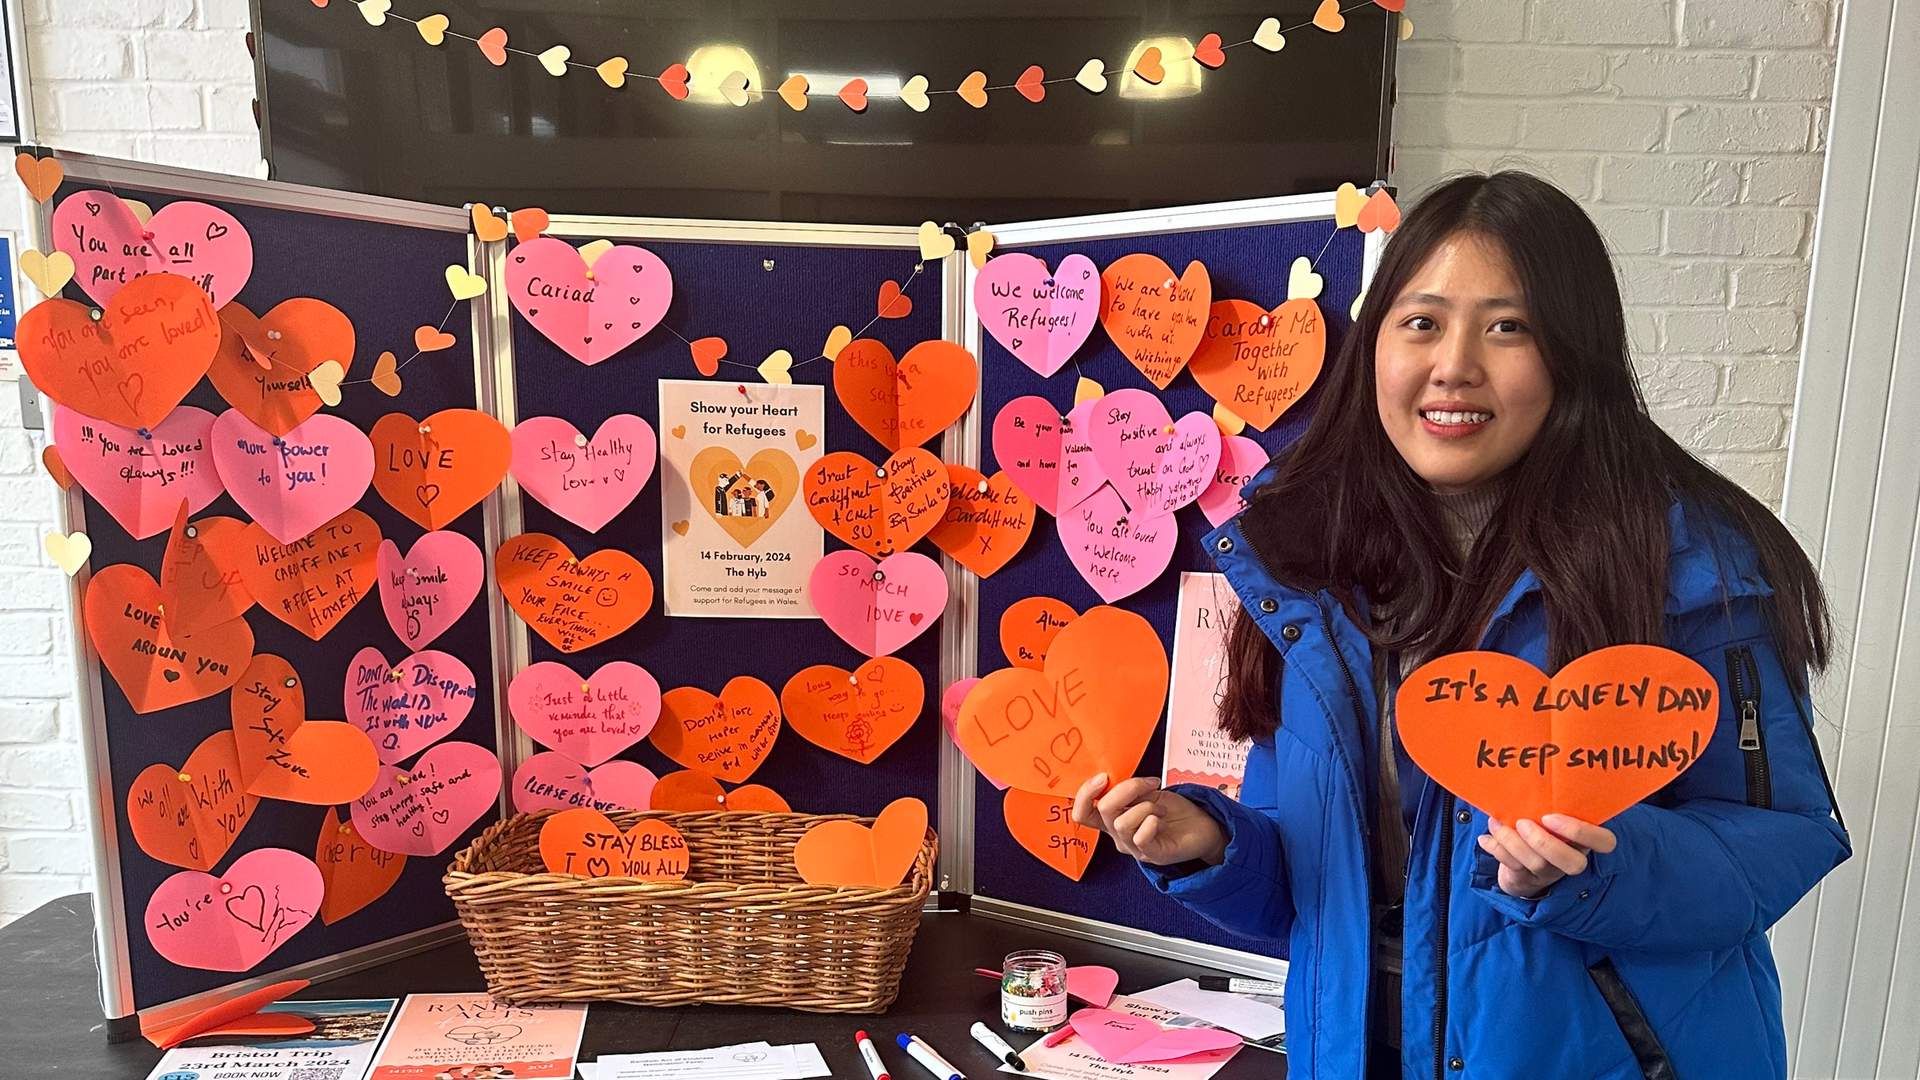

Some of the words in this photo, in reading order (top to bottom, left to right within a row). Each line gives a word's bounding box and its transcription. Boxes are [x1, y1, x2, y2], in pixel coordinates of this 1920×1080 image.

[71, 224, 108, 252] You
[122, 242, 152, 257] are
[168, 241, 194, 258] all
[92, 265, 126, 286] part
[526, 276, 596, 304] Cariad
[991, 281, 1022, 298] We
[1032, 284, 1086, 301] welcome
[1115, 275, 1135, 291] We
[1140, 285, 1161, 297] are
[1110, 294, 1126, 313] to
[1131, 297, 1160, 321] have
[1289, 309, 1317, 334] Met
[1125, 324, 1153, 340] with
[1232, 339, 1299, 371] Together
[690, 401, 727, 414] Show
[729, 406, 759, 418] your
[762, 404, 799, 417] Heart
[1107, 408, 1132, 425] Stay
[703, 422, 723, 435] for
[725, 423, 787, 439] Refugees
[1014, 416, 1026, 429] Be
[1035, 424, 1053, 438] your
[98, 433, 121, 457] You
[1120, 428, 1158, 449] positive
[389, 442, 455, 472] LOVE
[541, 440, 576, 473] Stay
[584, 437, 633, 466] Healthy
[890, 456, 917, 476] Stay
[258, 468, 272, 486] to
[1003, 486, 1019, 505] to
[326, 523, 354, 541] TO
[851, 525, 873, 540] SU
[1131, 524, 1158, 543] loved
[327, 542, 363, 564] MET
[512, 544, 559, 571] KEEP
[700, 551, 711, 561] 14
[714, 551, 763, 563] February,
[765, 552, 791, 562] 2024
[334, 568, 354, 588] AT
[725, 567, 745, 577] The
[747, 567, 768, 579] Hyb
[545, 575, 594, 595] SMILE
[690, 584, 712, 593] Come
[713, 585, 728, 593] and
[729, 585, 744, 593] add
[762, 586, 793, 595] message
[794, 586, 802, 594] of
[520, 586, 547, 607] YOUR
[562, 593, 581, 604] ON
[693, 597, 720, 606] support
[721, 597, 733, 605] for
[734, 596, 767, 606] Refugees
[776, 597, 799, 606] Wales.
[124, 602, 161, 630] LOVE
[245, 681, 282, 713] Stay
[543, 691, 574, 706] Just
[1424, 669, 1488, 703] IT'S
[1497, 685, 1519, 707] A
[1532, 677, 1650, 713] LOVELY
[1657, 685, 1712, 714] DAY
[601, 703, 626, 721] that
[731, 706, 753, 720] lose
[974, 668, 1087, 746] LOVE
[249, 717, 286, 745] Safe
[553, 728, 575, 743] you
[1476, 739, 1561, 776] KEEP
[1566, 730, 1699, 772] SMILING!
[419, 780, 445, 797] safe
[448, 768, 472, 786] and
[524, 775, 569, 801] PLEASE
[137, 789, 154, 809] We
[359, 794, 378, 813] You
[379, 785, 394, 800] are
[582, 832, 637, 859] STAY
[640, 834, 684, 852] BLESS
[621, 860, 651, 877] YOU
[656, 858, 686, 876] ALL
[155, 893, 214, 932] You're
[457, 1010, 535, 1020] ACTS
[1019, 1008, 1037, 1016] push
[1038, 1008, 1054, 1017] pins
[1124, 1003, 1161, 1012] Show
[180, 1062, 226, 1070] 23rd
[231, 1061, 299, 1069] March
[304, 1059, 351, 1068] 2024
[209, 1050, 279, 1059] Bristol
[290, 1050, 333, 1059] Trip
[213, 1072, 248, 1080] BOOK
[250, 1071, 282, 1080] NOW
[1088, 1063, 1109, 1071] The
[1111, 1066, 1135, 1075] Hyb
[1140, 1065, 1171, 1074] 2024
